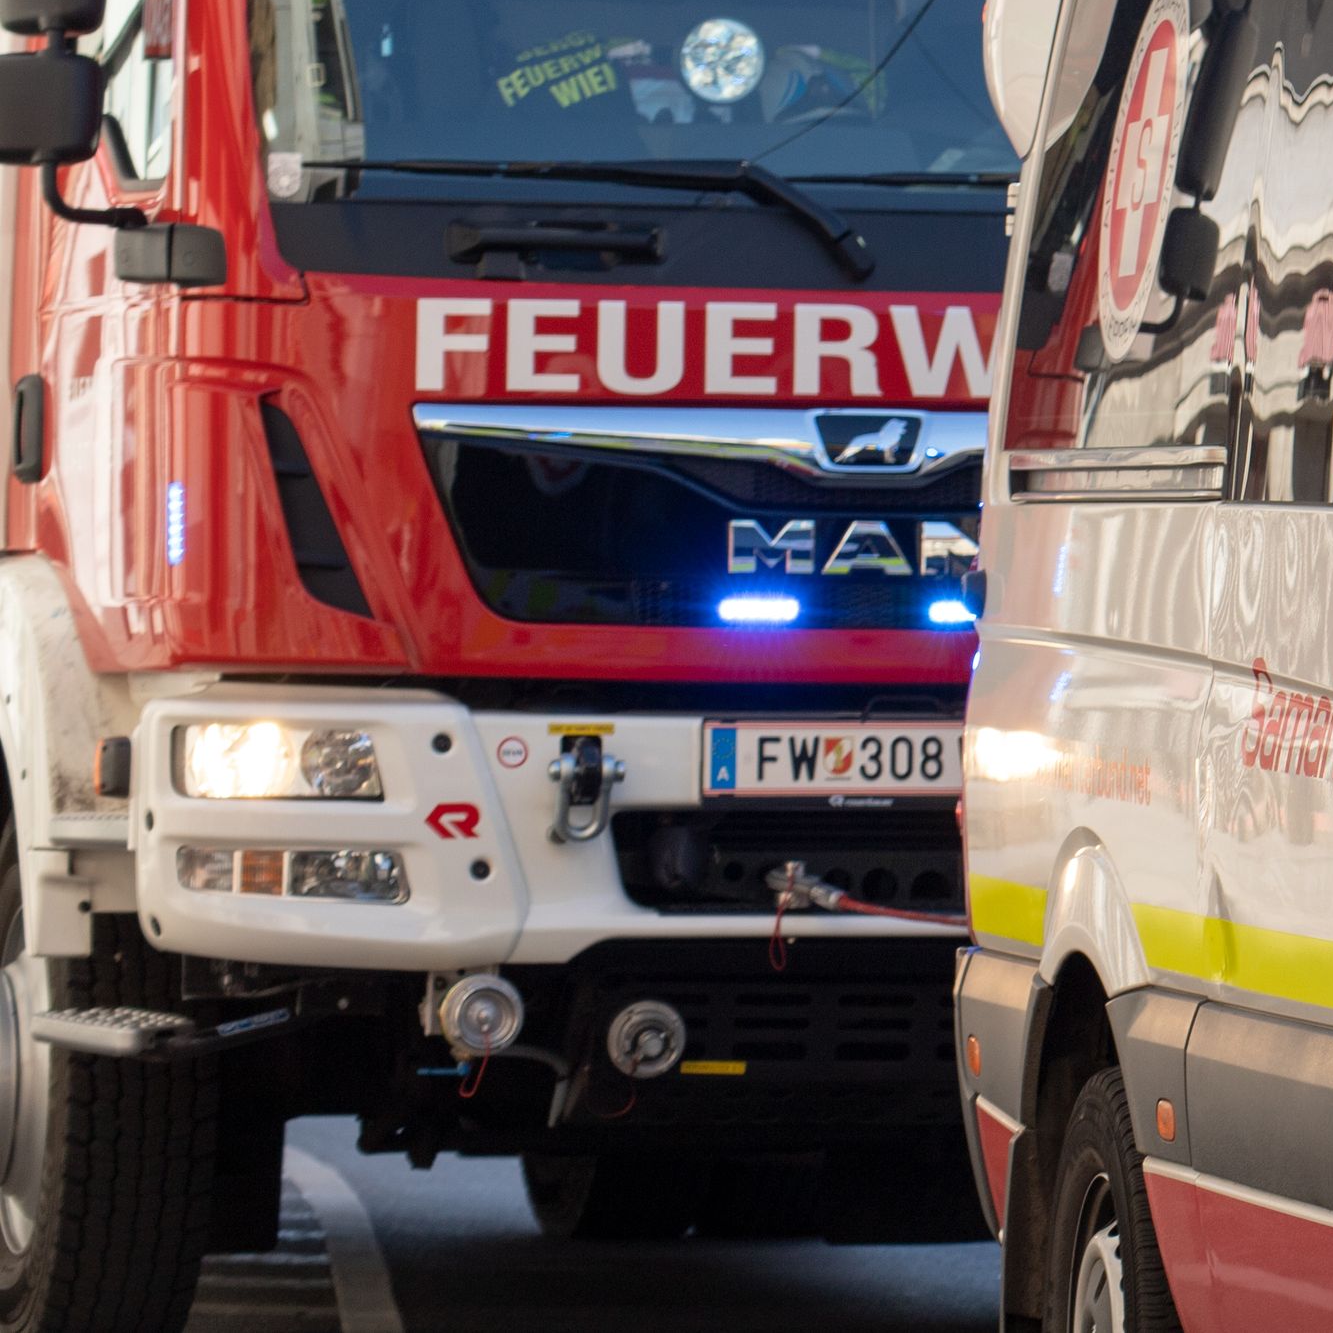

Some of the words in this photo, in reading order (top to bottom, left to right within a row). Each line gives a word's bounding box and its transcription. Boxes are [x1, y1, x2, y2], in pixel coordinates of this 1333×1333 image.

[415, 297, 1000, 398] FEUERW
[727, 519, 980, 576] MAN
[716, 766, 730, 782] A
[757, 734, 821, 783] FW
[859, 734, 944, 782] 308
